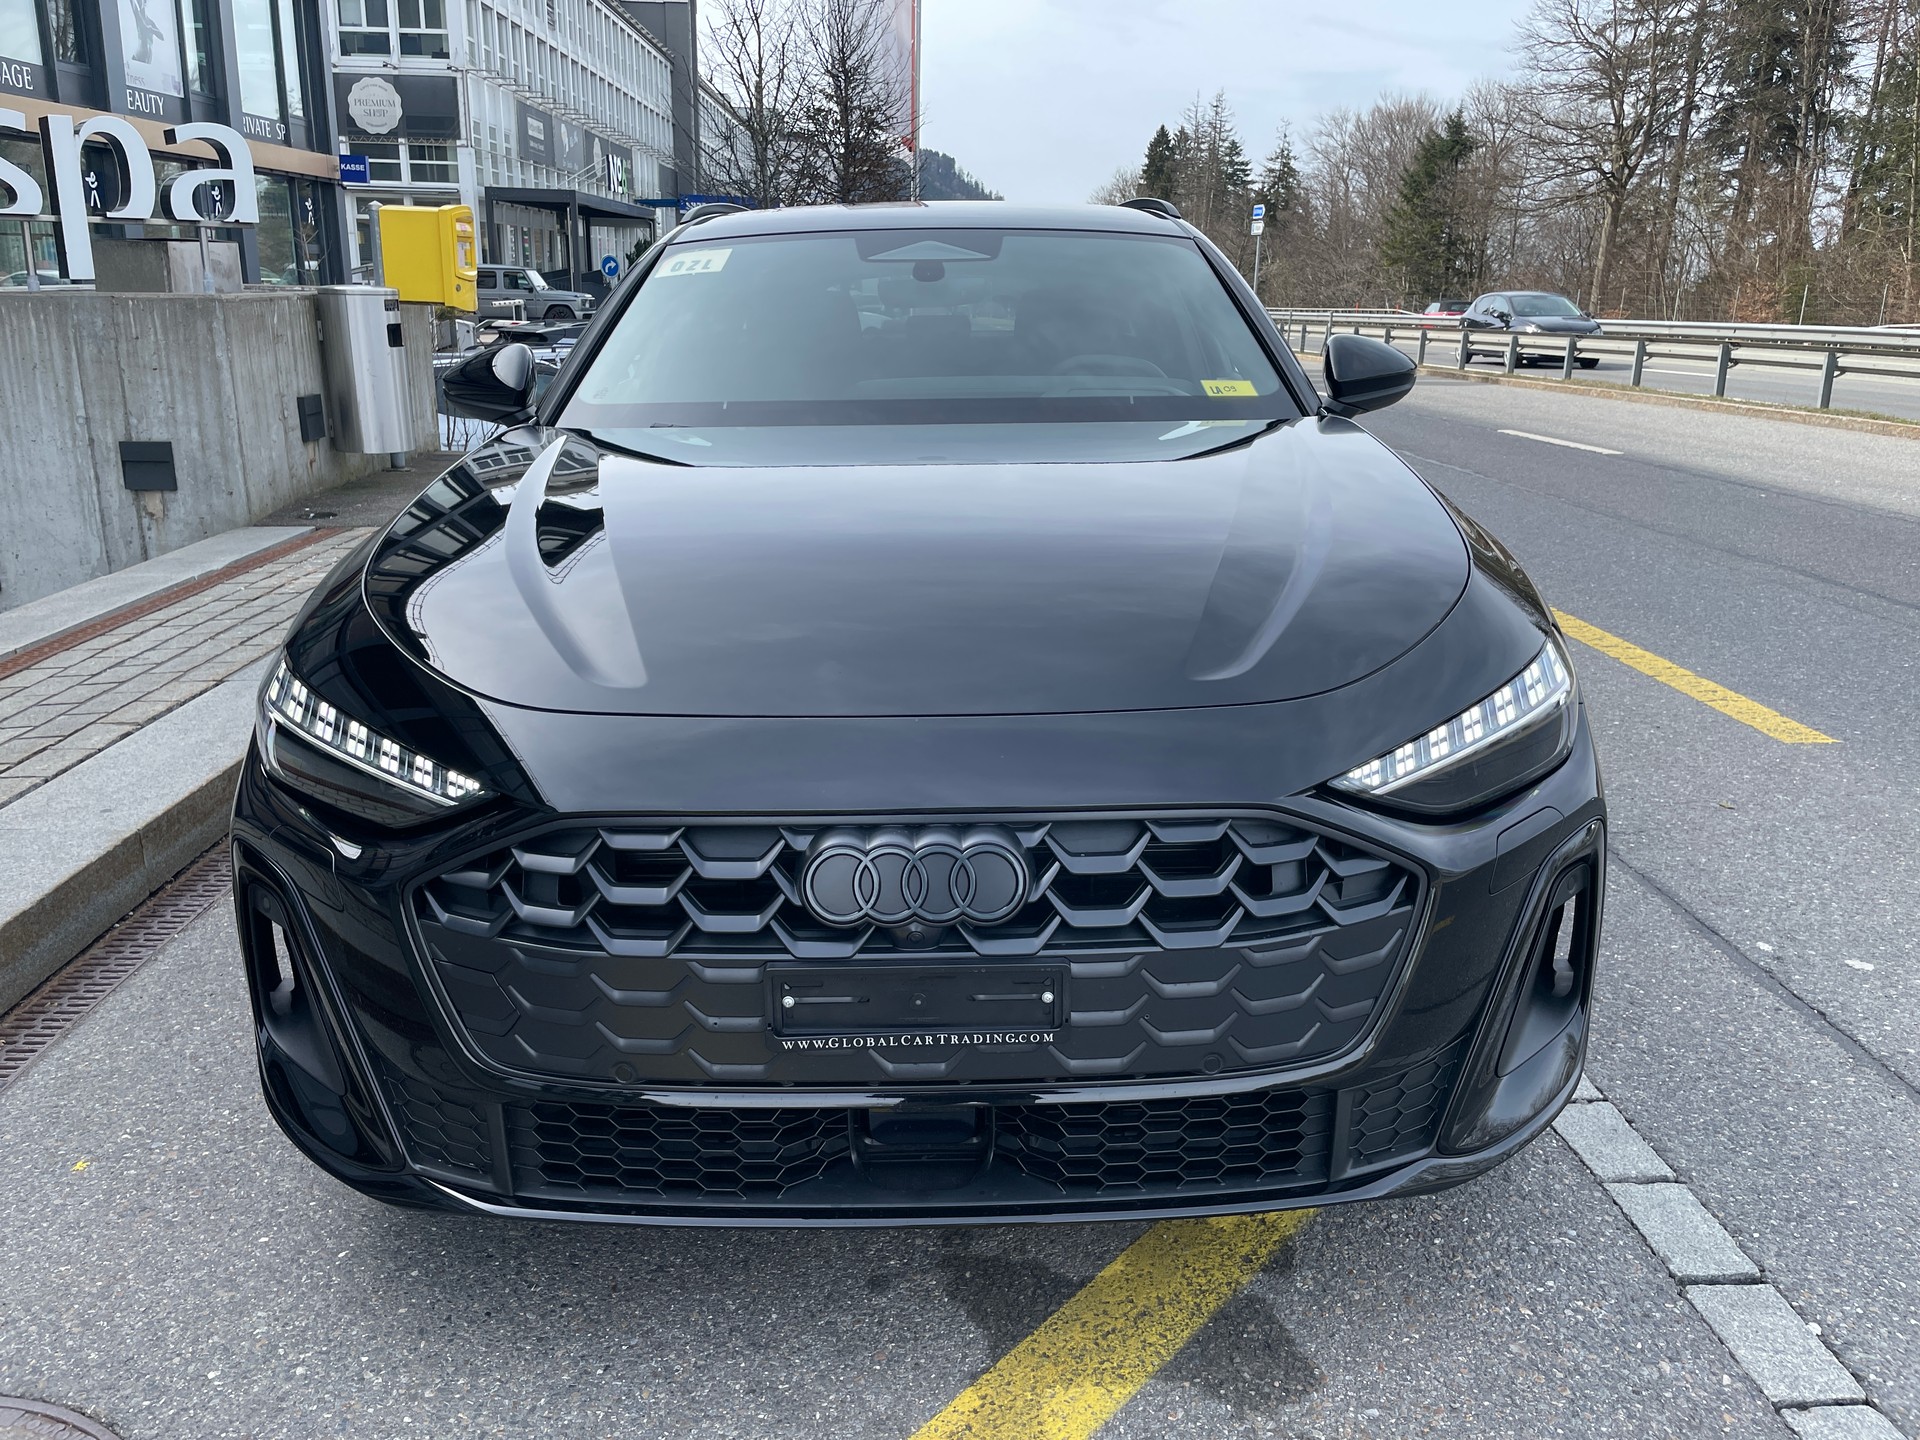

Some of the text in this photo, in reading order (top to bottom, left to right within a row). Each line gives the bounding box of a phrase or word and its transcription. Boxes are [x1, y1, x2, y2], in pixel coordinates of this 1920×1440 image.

[126, 89, 164, 116] EAUTY
[354, 98, 396, 108] PREMIUM
[363, 108, 389, 118] SHOP
[340, 163, 366, 172] KASSE
